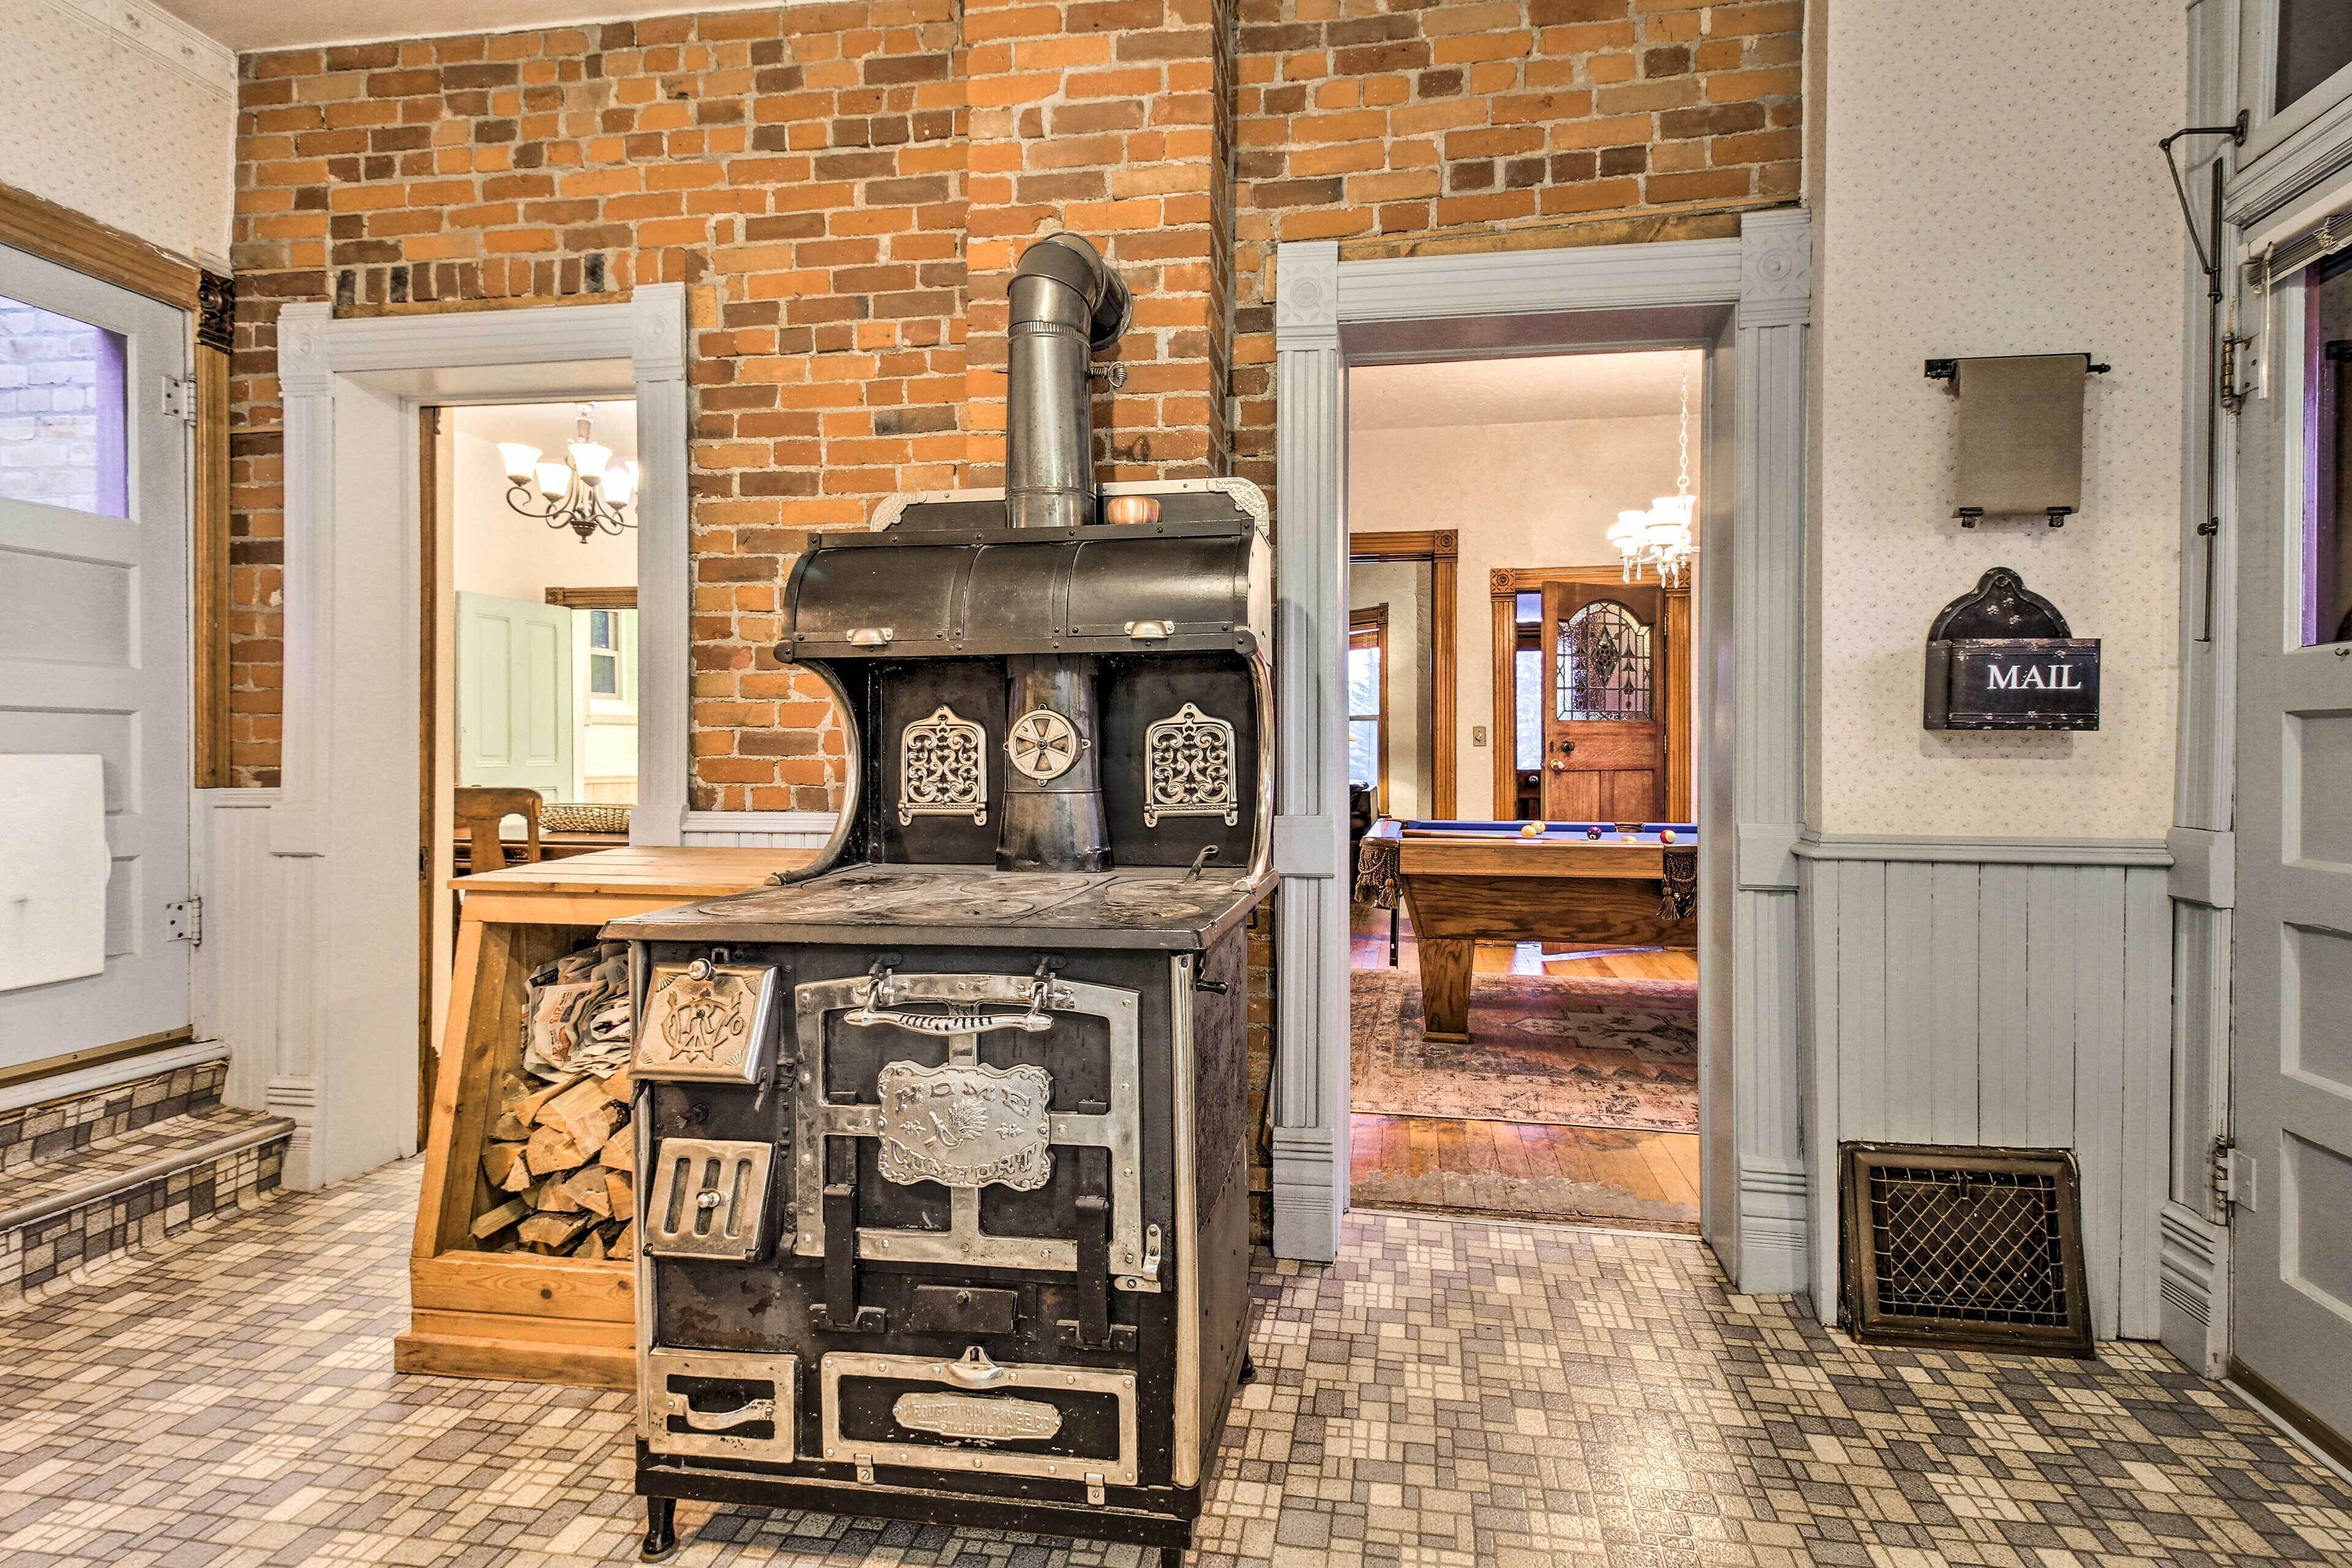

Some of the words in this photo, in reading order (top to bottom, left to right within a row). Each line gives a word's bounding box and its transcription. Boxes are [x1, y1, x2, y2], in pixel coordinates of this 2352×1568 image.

[1986, 665, 2082, 690] MAIL
[894, 1080, 1031, 1119] HOME
[888, 1137, 1037, 1178] COMFORT
[903, 1401, 958, 1417] WROUGHT
[960, 1403, 987, 1417] IRON
[992, 1406, 1031, 1427] RANGE
[959, 1422, 994, 1433] LOUIS
